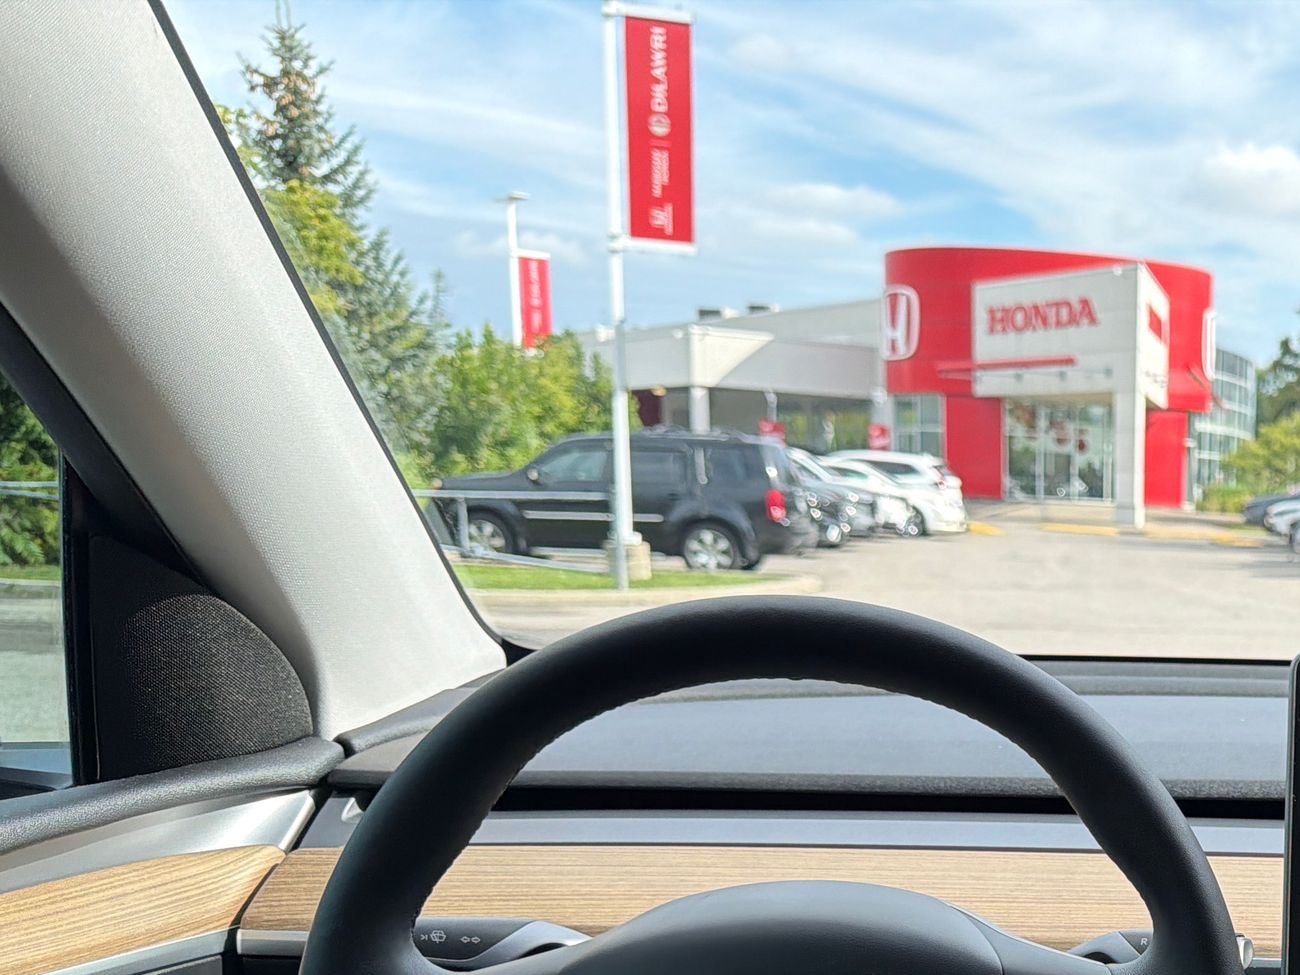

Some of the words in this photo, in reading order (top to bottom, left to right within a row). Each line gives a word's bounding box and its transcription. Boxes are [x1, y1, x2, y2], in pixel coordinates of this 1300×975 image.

[650, 26, 668, 113] DILAWRI
[987, 297, 1098, 336] HONDA
[1140, 937, 1149, 946] R
